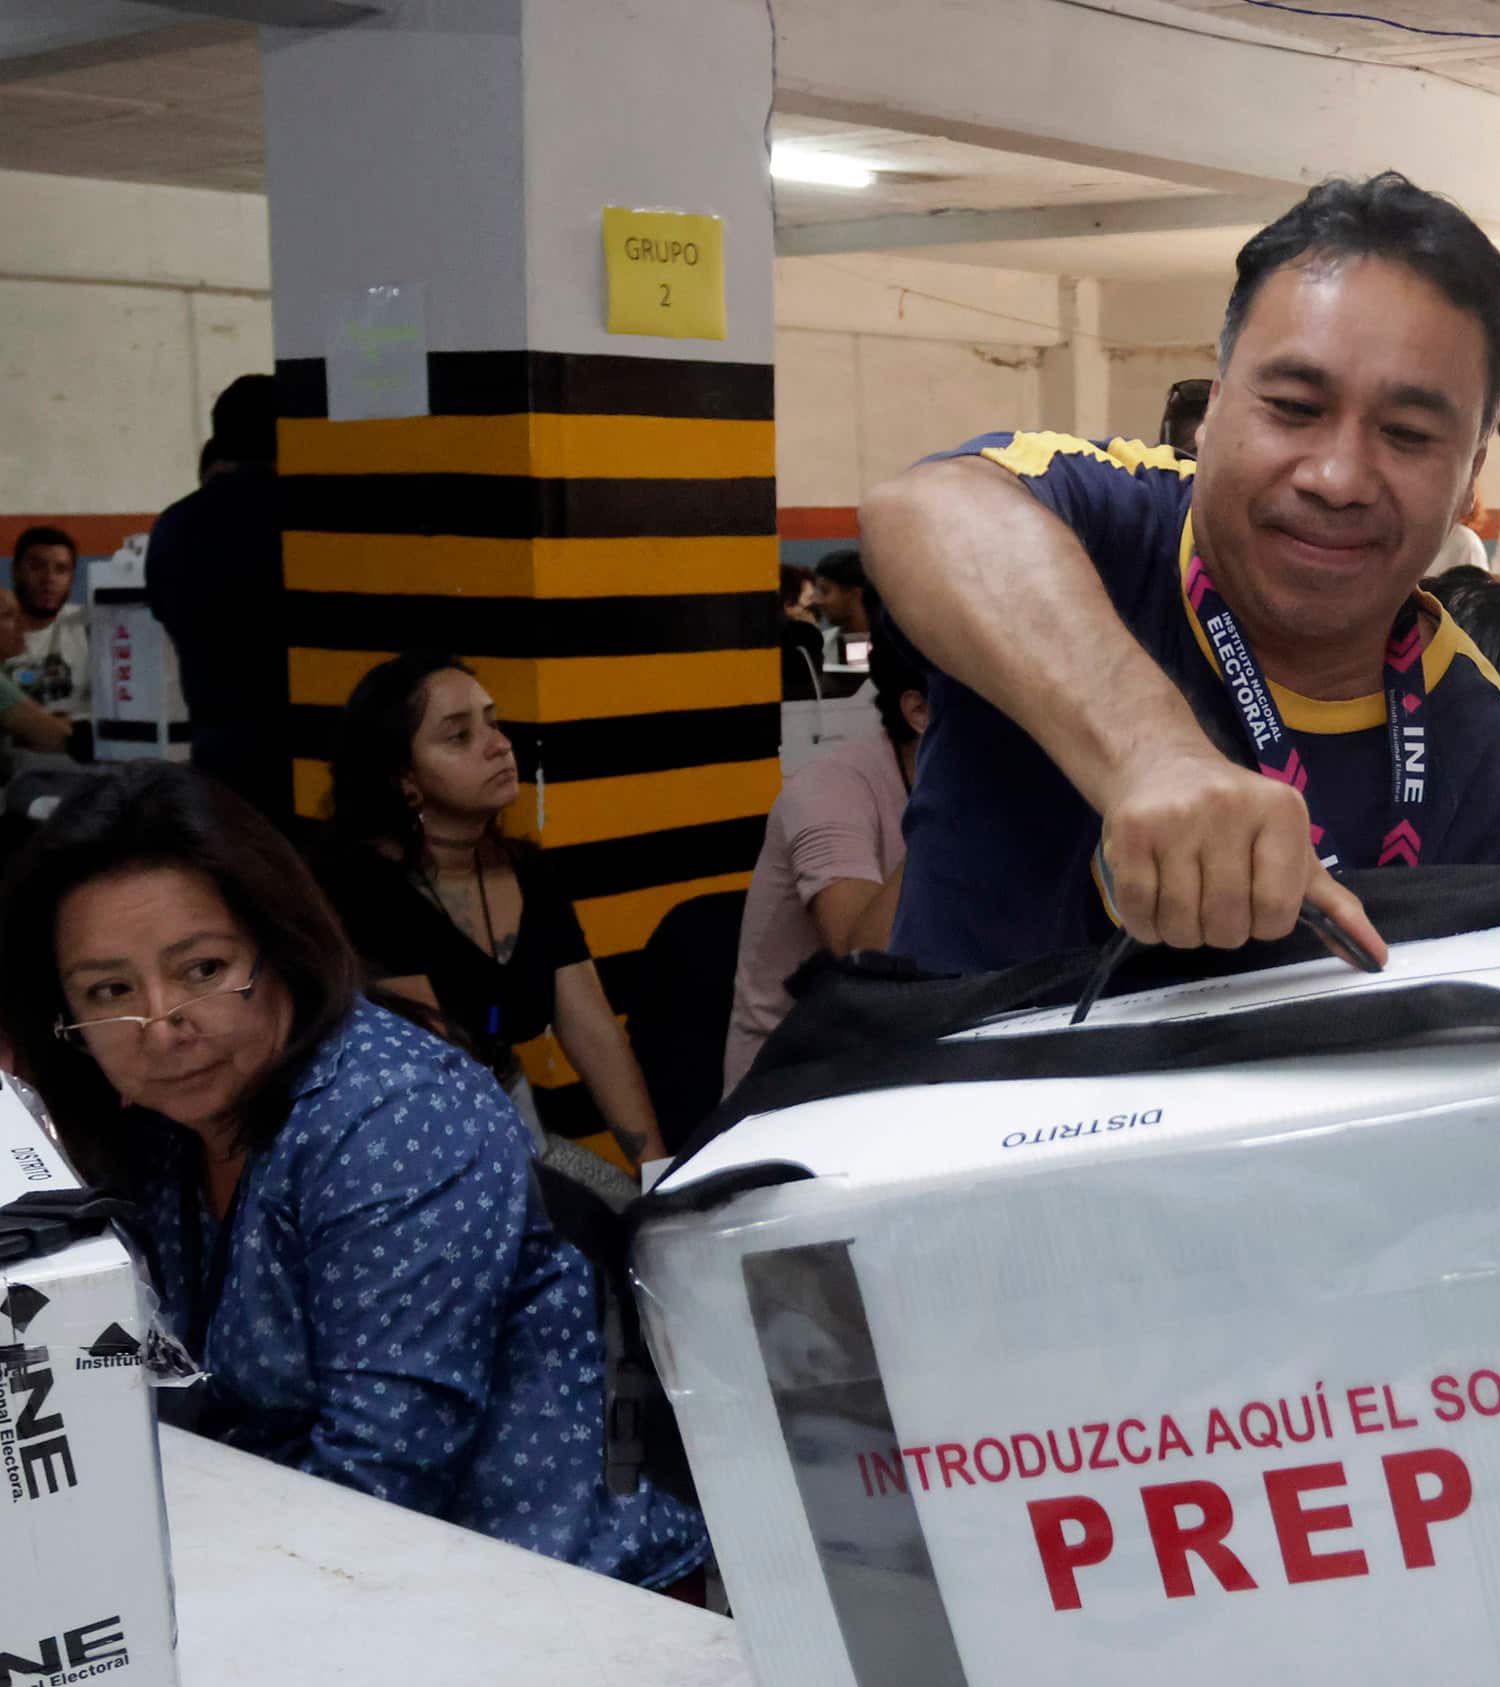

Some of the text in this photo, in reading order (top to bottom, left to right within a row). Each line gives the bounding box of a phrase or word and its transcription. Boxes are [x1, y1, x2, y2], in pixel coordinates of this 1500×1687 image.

[624, 236, 699, 266] GRUPO
[659, 283, 671, 307] 2
[1207, 615, 1272, 751] ELECTORAL
[1221, 611, 1284, 743] INSTITUTO NACIONAL
[1403, 726, 1425, 803] INE
[11, 1147, 52, 1181] DISTRITO
[1001, 1108, 1164, 1148] DISTRITO
[857, 1418, 1194, 1497] INTRODUZCA
[1206, 1381, 1334, 1454] AQUÍ
[1346, 1385, 1418, 1434] EL
[1026, 1447, 1473, 1612] PREP
[0, 1615, 127, 1687] NE
[50, 1654, 129, 1687] Electoral
